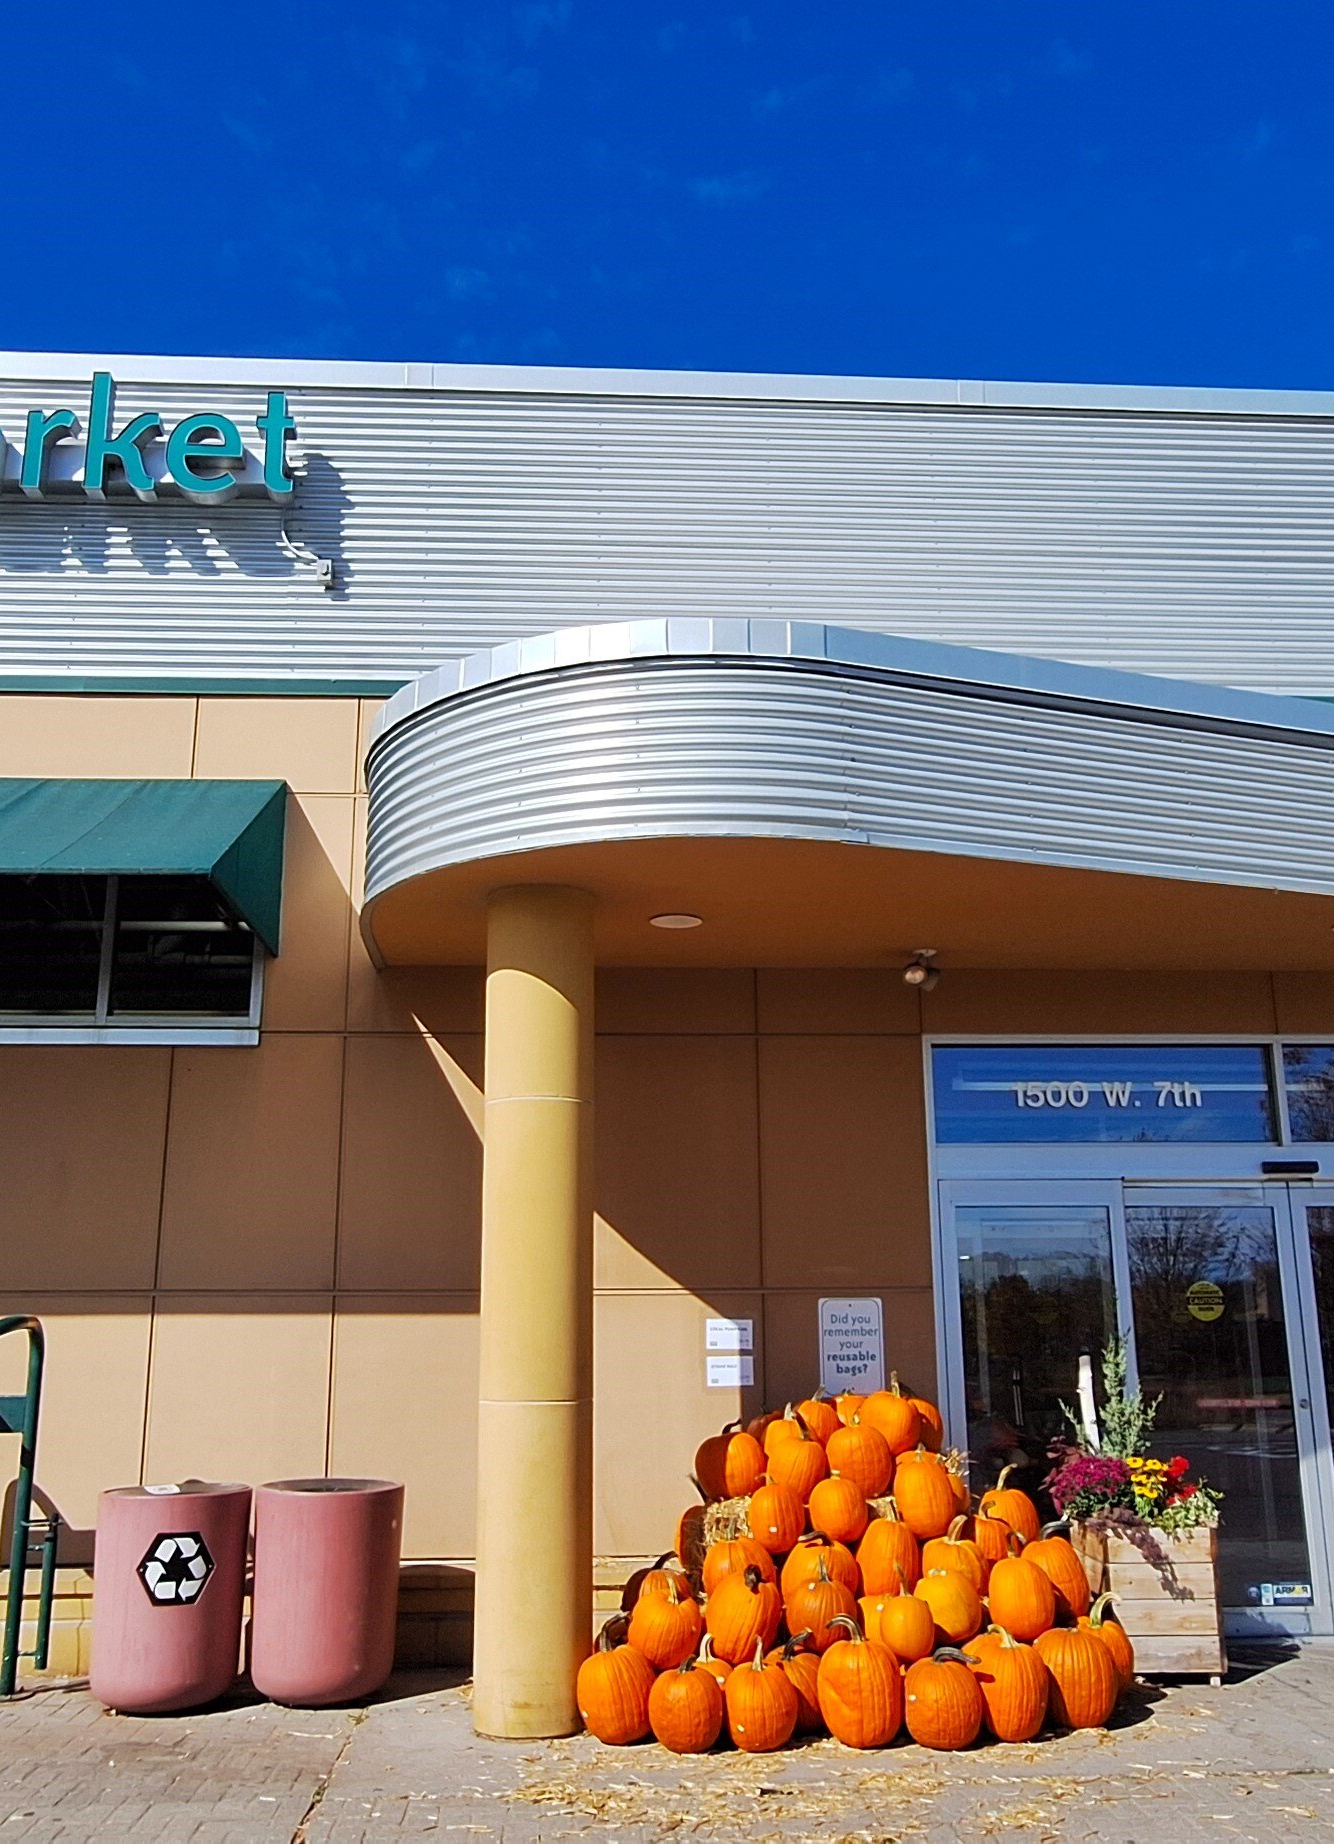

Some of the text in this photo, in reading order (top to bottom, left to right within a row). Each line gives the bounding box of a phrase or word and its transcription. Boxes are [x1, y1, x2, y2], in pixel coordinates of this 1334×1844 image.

[1013, 1081, 1202, 1107] 1500 W. 7th
[830, 1313, 871, 1327] Did you
[823, 1326, 878, 1337] remember
[839, 1341, 864, 1351] your
[827, 1351, 877, 1362] reusable
[836, 1363, 868, 1376] bags?
[1274, 1586, 1308, 1595] ARMR
